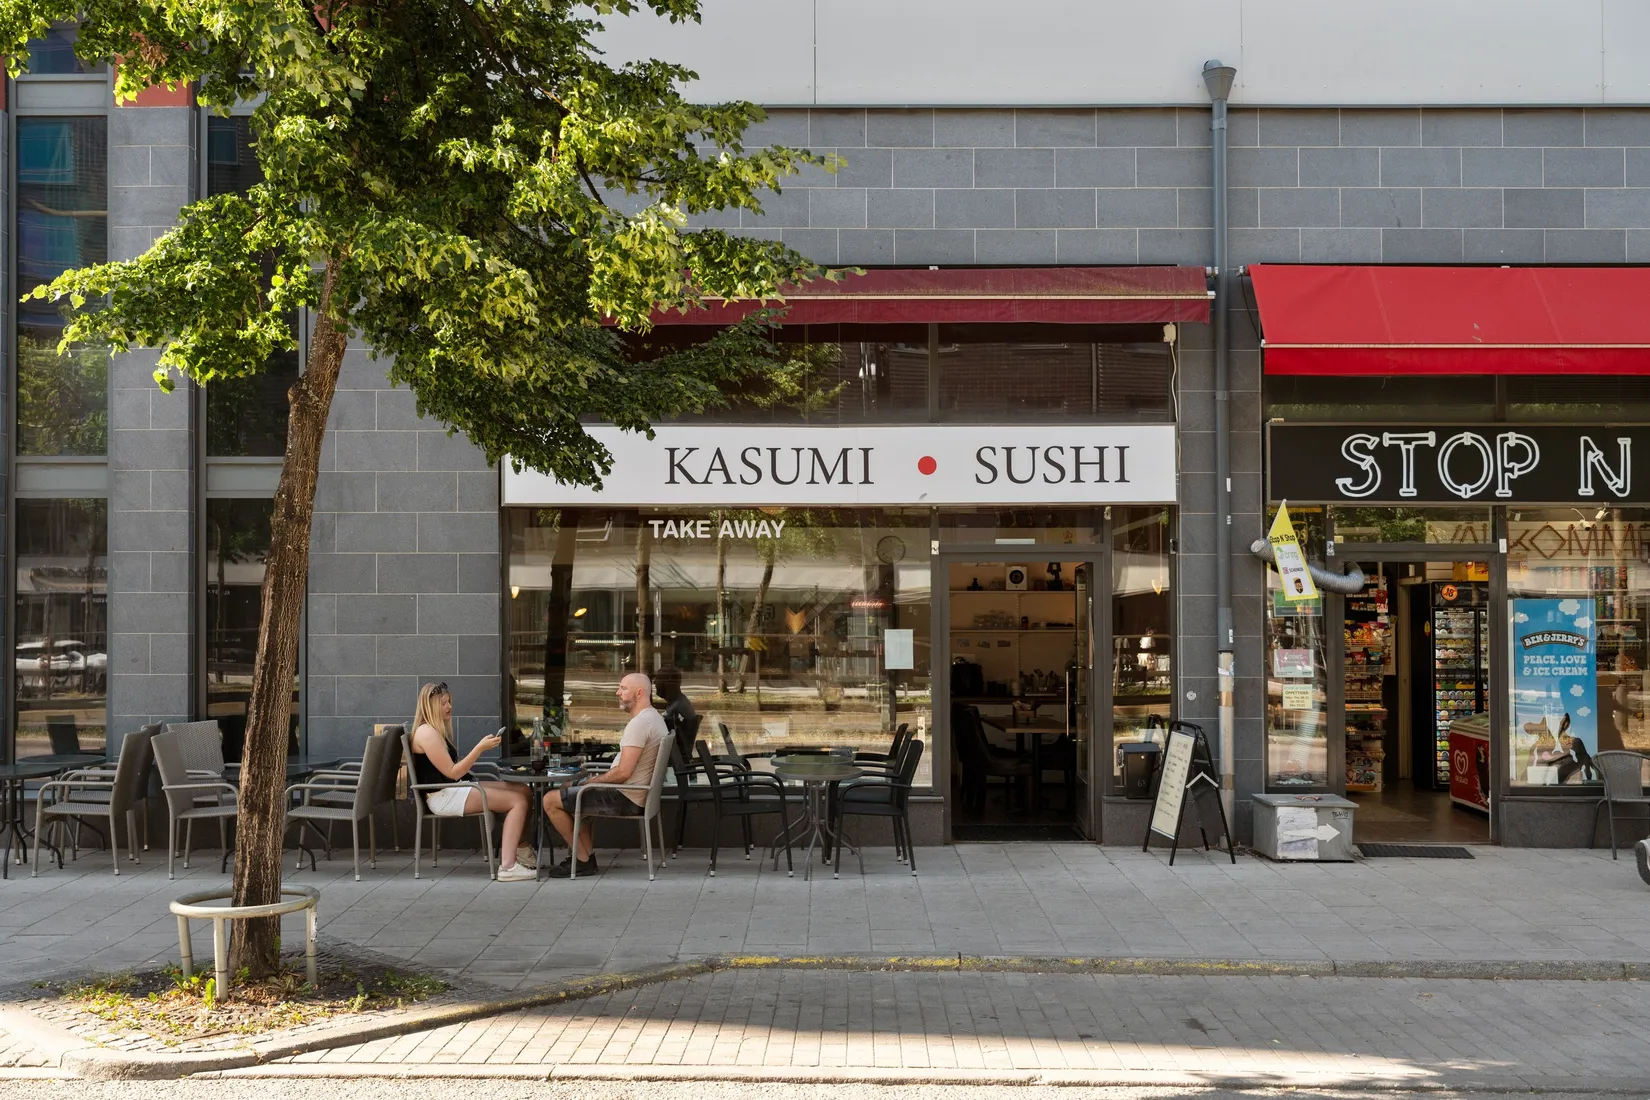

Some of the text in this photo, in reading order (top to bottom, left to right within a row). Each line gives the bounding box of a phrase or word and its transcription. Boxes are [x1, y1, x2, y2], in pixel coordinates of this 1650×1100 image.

[664, 445, 1131, 486] KASUMI SUSHI
[1335, 430, 1632, 499] STOP N
[648, 520, 786, 539] TAKE AWAY
[1284, 534, 1296, 542] Shop
[1523, 655, 1559, 664] PEACE,
[1560, 655, 1587, 664] LOVE
[1523, 666, 1588, 676] & ICE CREAM
